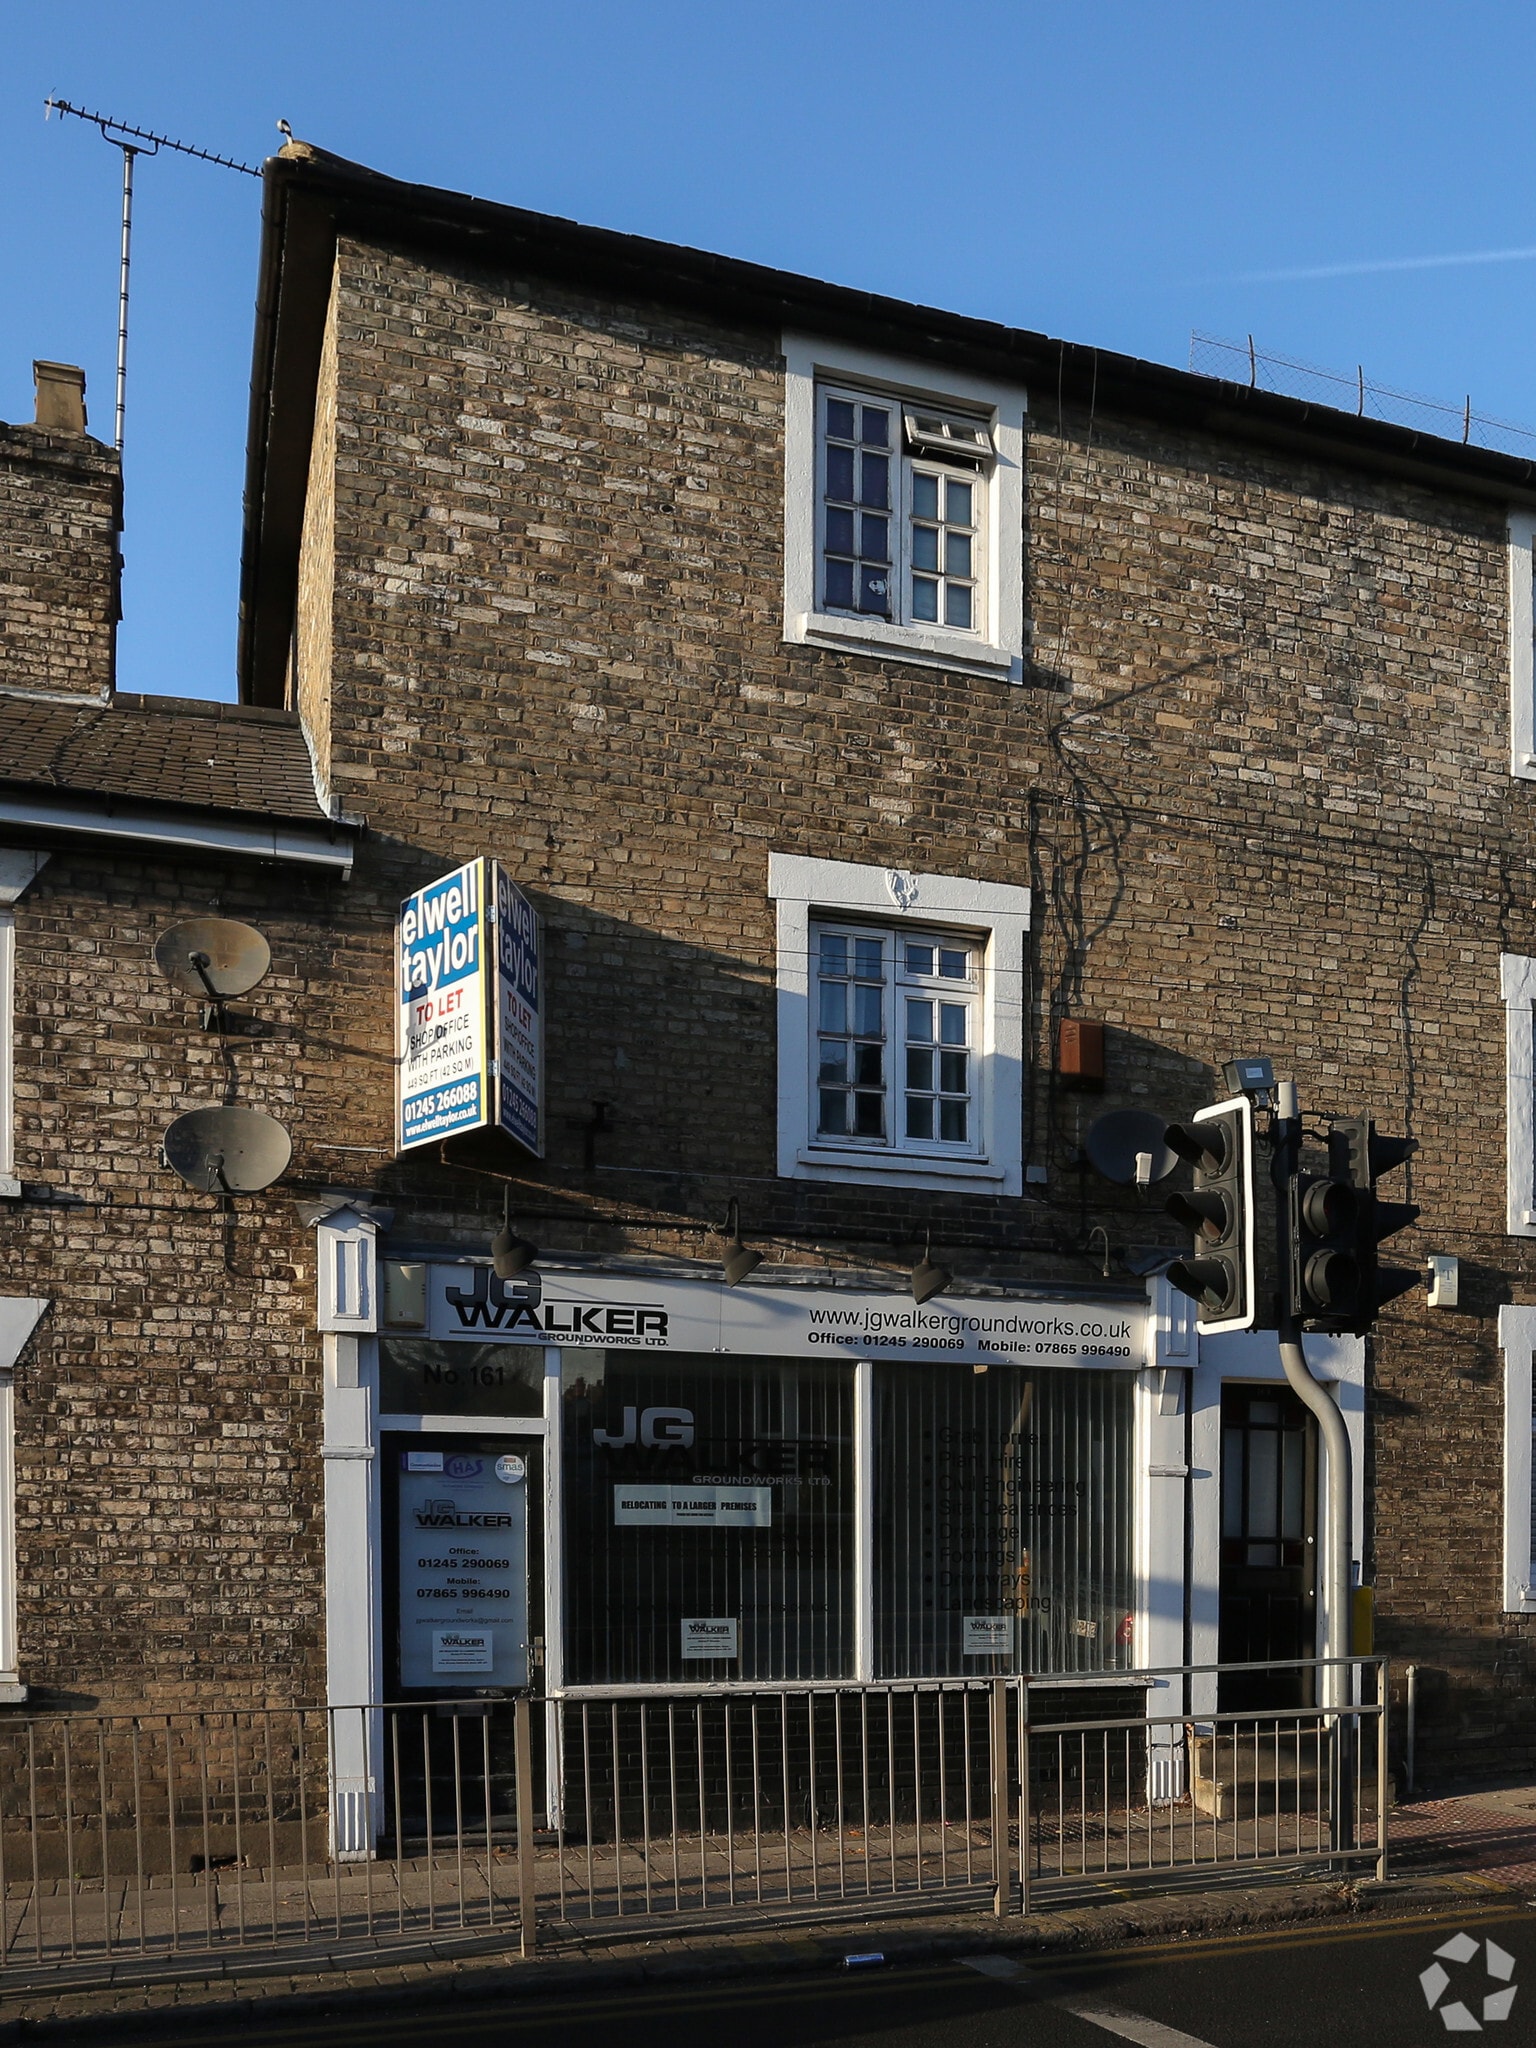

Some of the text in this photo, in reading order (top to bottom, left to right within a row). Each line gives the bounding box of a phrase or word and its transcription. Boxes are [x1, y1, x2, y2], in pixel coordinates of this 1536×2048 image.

[402, 862, 477, 946] elwell
[499, 877, 537, 955] elwell
[401, 923, 479, 993] taylor
[499, 918, 538, 998] taylor
[416, 988, 463, 1026] TO LET
[507, 990, 531, 1032] TO LET
[407, 1035, 472, 1072] WITH PARKING
[430, 1069, 438, 1083] FT
[452, 1060, 463, 1074] SQ
[405, 1081, 477, 1122] 01245 266088
[405, 1103, 477, 1137] www.elwelltaylor.co.uk
[1442, 1269, 1454, 1280] T
[445, 1266, 543, 1310] JG
[453, 1300, 669, 1337] WALKER
[808, 1307, 1131, 1339] www.jgwalkergroundworks.co.uk
[537, 1332, 669, 1347] GROUNDWORKS LTD.
[807, 1331, 1131, 1357] Office: 01245 290069 Mobile: 07865 996490
[593, 1406, 695, 1449] JG
[938, 1427, 983, 1444] Grab
[496, 1463, 523, 1471] smas
[938, 1451, 1025, 1470] Plant Hire
[692, 1475, 833, 1486] GROUNDWORKS LTD.
[938, 1475, 1086, 1496] Civil Engineering
[413, 1499, 455, 1517] JG
[621, 1501, 757, 1511] RELOCATING TO A LARGER PREMISES
[938, 1499, 1078, 1517] Site Clearances
[416, 1514, 512, 1528] WALKER
[940, 1524, 1020, 1544] Drainage
[448, 1547, 479, 1556] Office:
[940, 1547, 1016, 1567] Footings
[417, 1558, 510, 1569] 01245 290069
[446, 1577, 480, 1585] Mobile:
[940, 1571, 1031, 1590] Driveways
[416, 1588, 510, 1599] 07865 996490
[940, 1594, 1051, 1613] Landscaping
[688, 1624, 730, 1633] WALKER
[441, 1636, 485, 1646] WALKER
